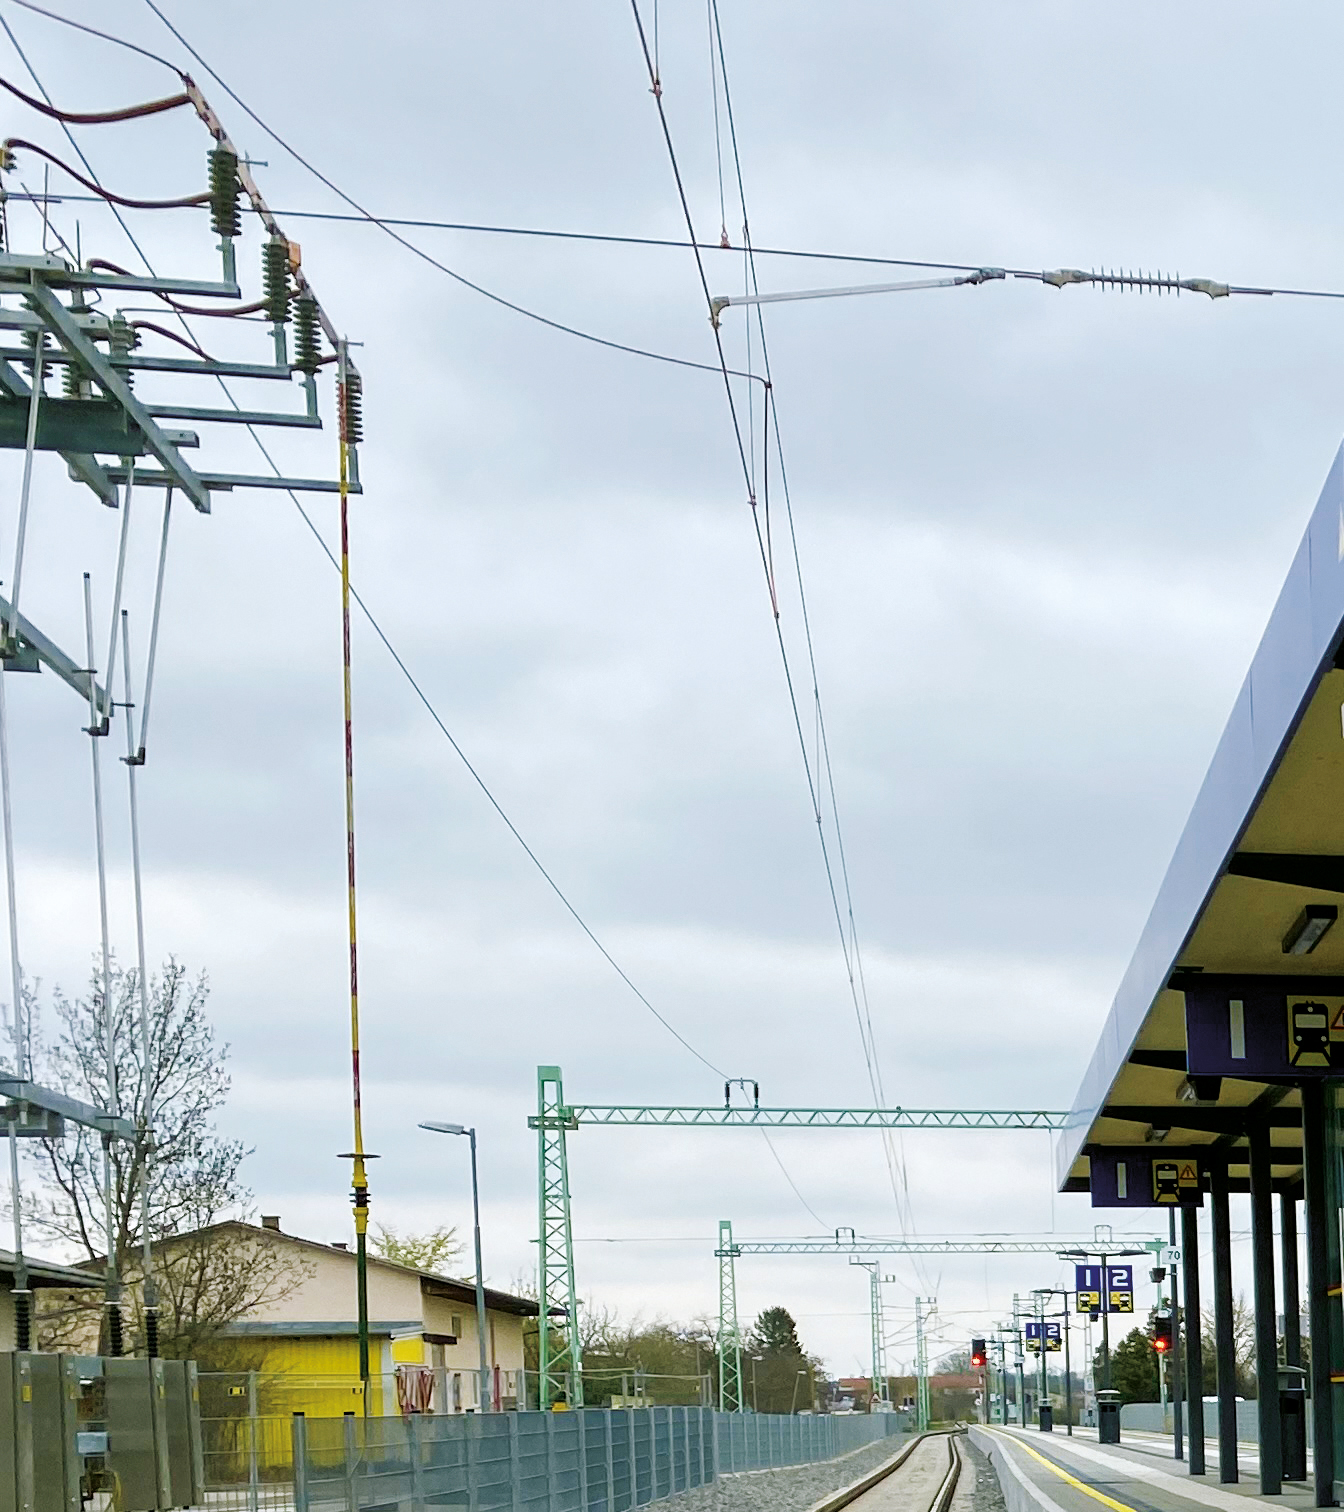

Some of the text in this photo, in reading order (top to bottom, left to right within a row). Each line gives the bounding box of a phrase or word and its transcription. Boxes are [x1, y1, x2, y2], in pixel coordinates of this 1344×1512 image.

[1167, 1250, 1181, 1261] 70
[1111, 1269, 1129, 1287] 2
[1047, 1324, 1059, 1336] 2
